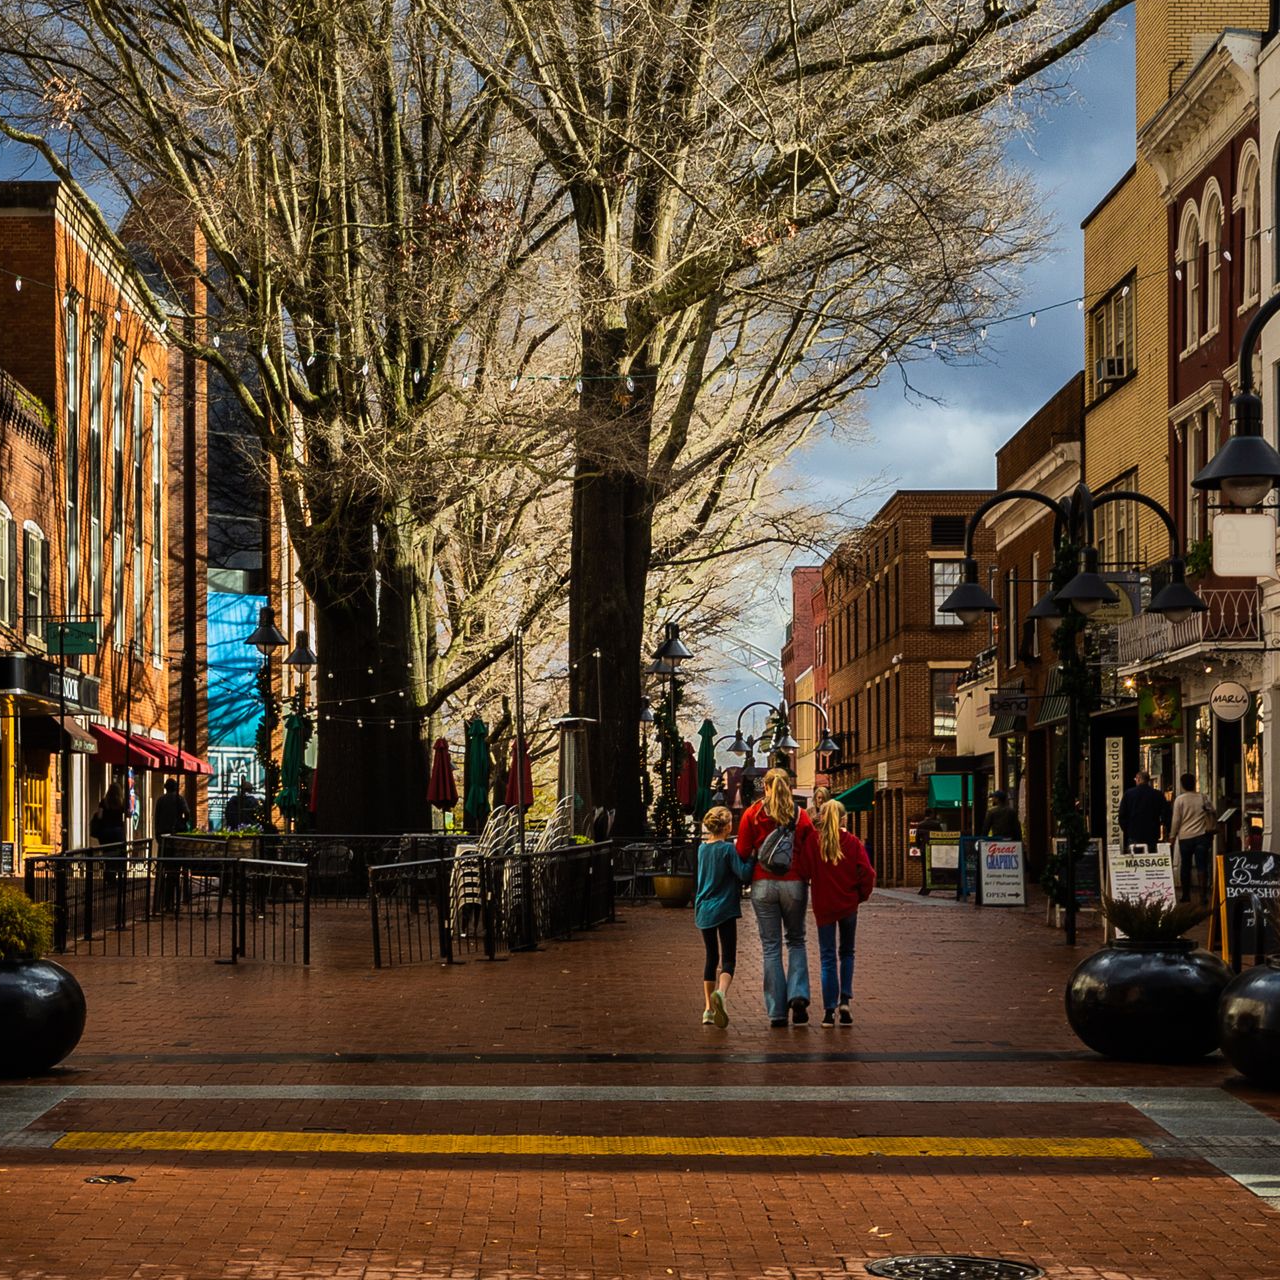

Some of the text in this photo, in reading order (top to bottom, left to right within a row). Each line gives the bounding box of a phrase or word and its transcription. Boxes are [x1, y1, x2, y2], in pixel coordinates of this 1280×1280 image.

[63, 677, 79, 700] NOOK
[1107, 741, 1120, 781] studio
[988, 843, 1016, 855] Great
[986, 854, 1019, 870] GRAPHICS
[1125, 858, 1170, 868] MASSAGE
[1229, 856, 1258, 869] New
